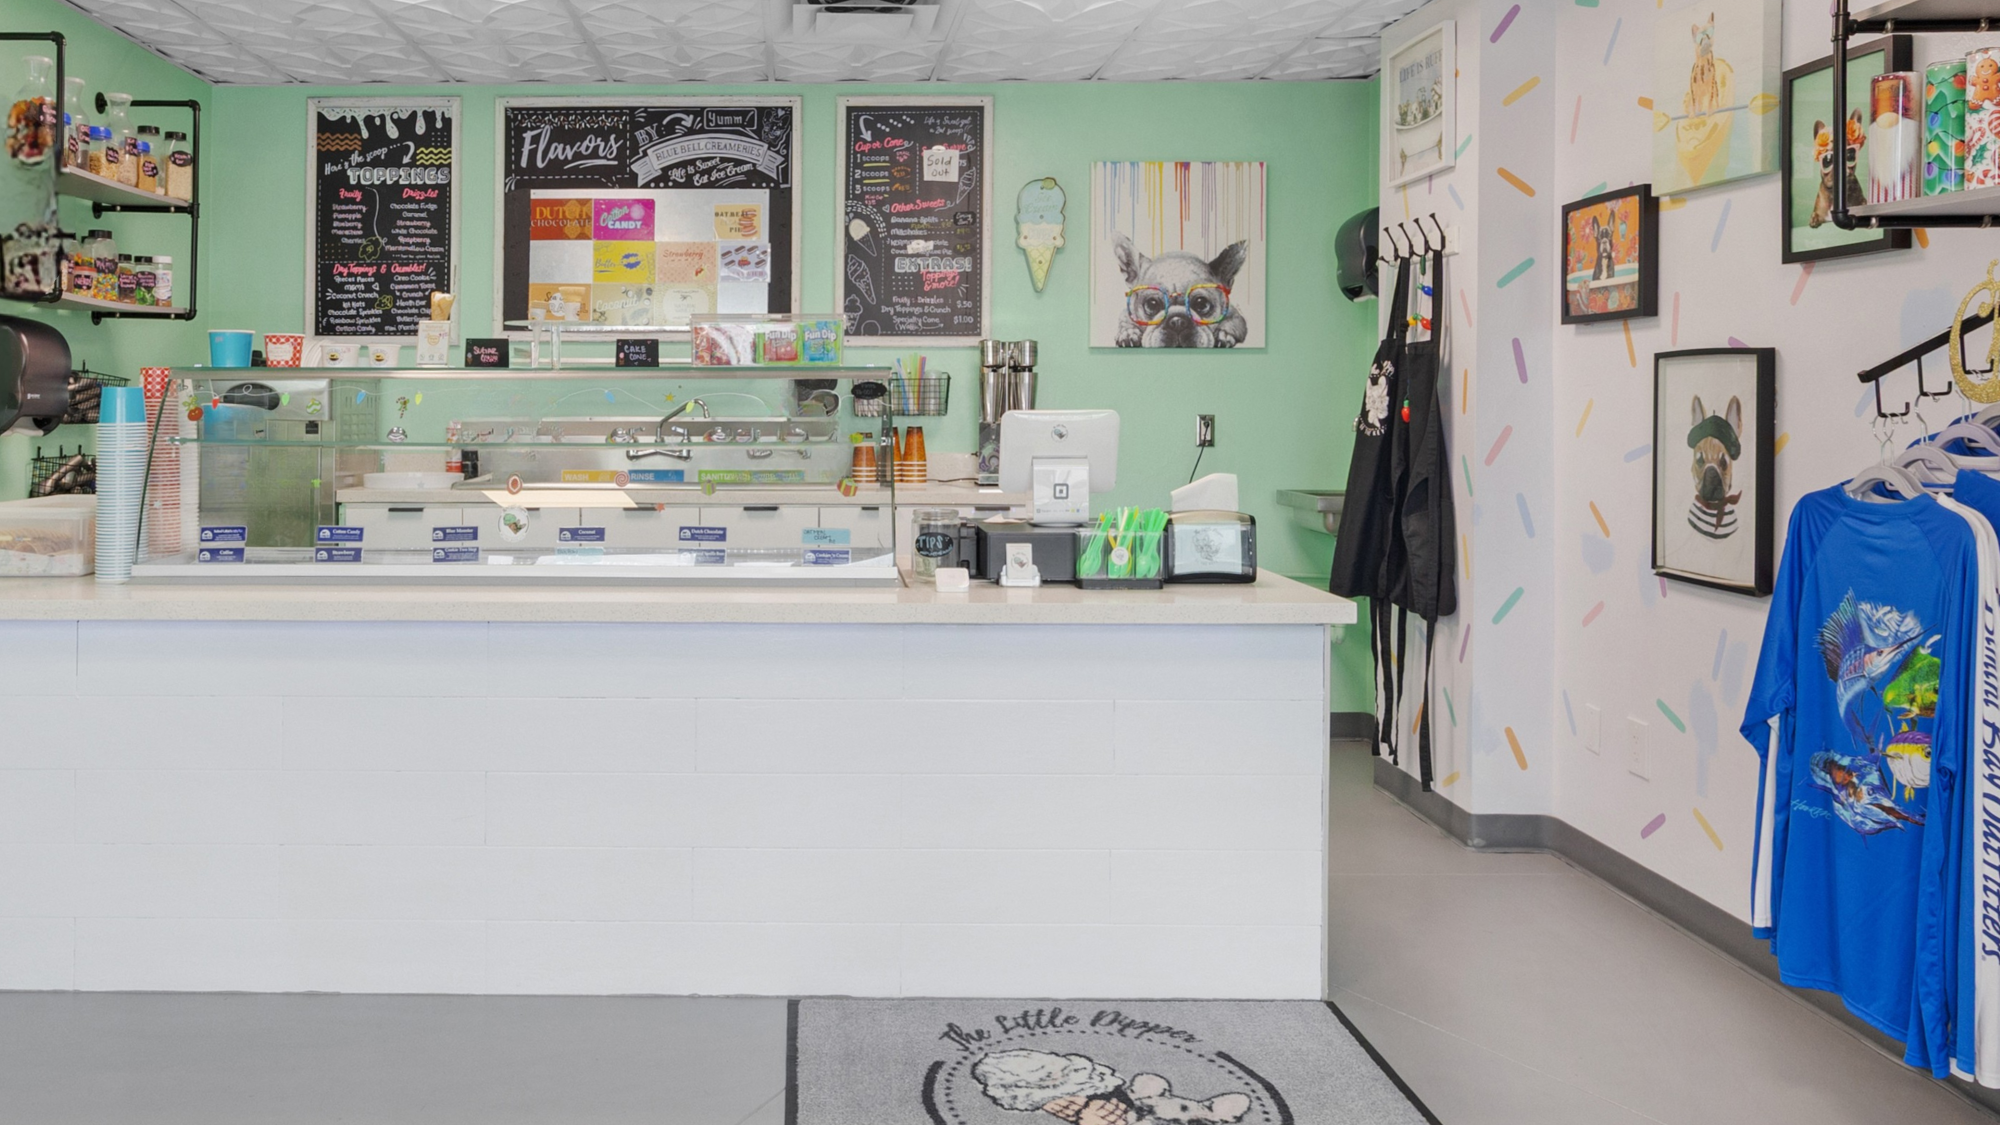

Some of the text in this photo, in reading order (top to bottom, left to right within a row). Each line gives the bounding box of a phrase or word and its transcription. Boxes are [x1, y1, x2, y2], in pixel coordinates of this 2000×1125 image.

[520, 125, 624, 169] Flavors
[654, 141, 762, 162] BLUE BELL CREAMERIES
[855, 141, 870, 153] Cup
[883, 137, 905, 148] Cone
[348, 150, 365, 166] the
[365, 147, 389, 162] scoop
[927, 154, 952, 167] Sold
[346, 166, 451, 185] TOPPINGS
[668, 156, 721, 183] Life is Sweet
[692, 162, 755, 187] Eat Ice Cream
[855, 169, 862, 179] 2
[339, 188, 363, 202] Fruity
[855, 184, 862, 194] 3
[535, 206, 587, 220] DUTCH
[890, 199, 946, 213] Other Sweets
[530, 219, 592, 227] CHOCOLATE
[600, 205, 630, 227] Cotton
[607, 220, 643, 229] CANDY
[662, 249, 704, 260] Strawberry
[348, 262, 377, 276] Toppings
[894, 256, 973, 273] EXTRAS!
[919, 268, 959, 282] Toppings
[953, 315, 974, 325] $1.00
[764, 329, 797, 341] Fun Dip
[804, 329, 837, 342] Fun Dip
[624, 344, 647, 353] CAKE
[629, 353, 647, 361] CONE
[564, 473, 589, 481] WASH
[630, 472, 655, 480] RINSE
[918, 534, 944, 549] TIPS
[938, 1007, 1204, 1051] The Little Dipper
